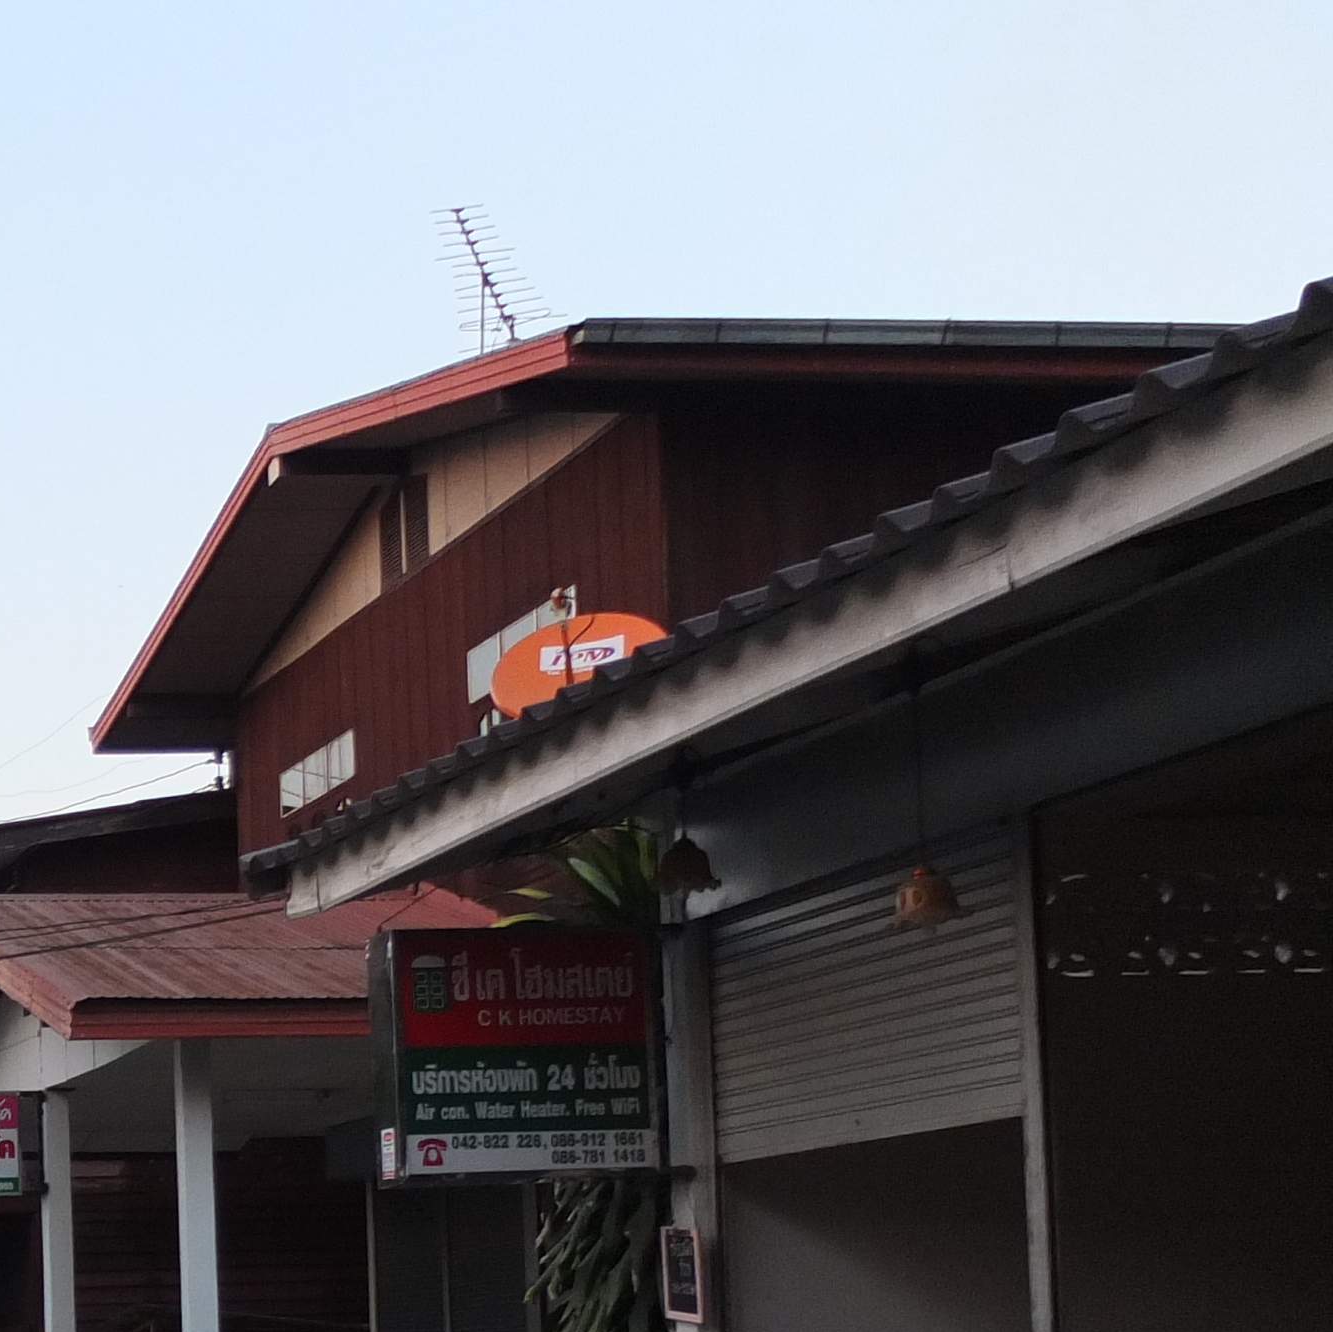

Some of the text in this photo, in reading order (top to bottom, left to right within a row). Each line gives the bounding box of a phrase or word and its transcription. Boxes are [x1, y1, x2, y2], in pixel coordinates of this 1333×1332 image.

[511, 947, 634, 998] โฮมสเตย์
[477, 1005, 627, 1027] C K HOMESTAY
[412, 1052, 640, 1095] บริการห้องพัก 24 ชั่วโมง
[415, 1102, 435, 1121] Air
[440, 1104, 470, 1120] con.
[475, 1101, 515, 1120] Water
[575, 1098, 605, 1116] Free
[451, 1134, 509, 1150] 042-822
